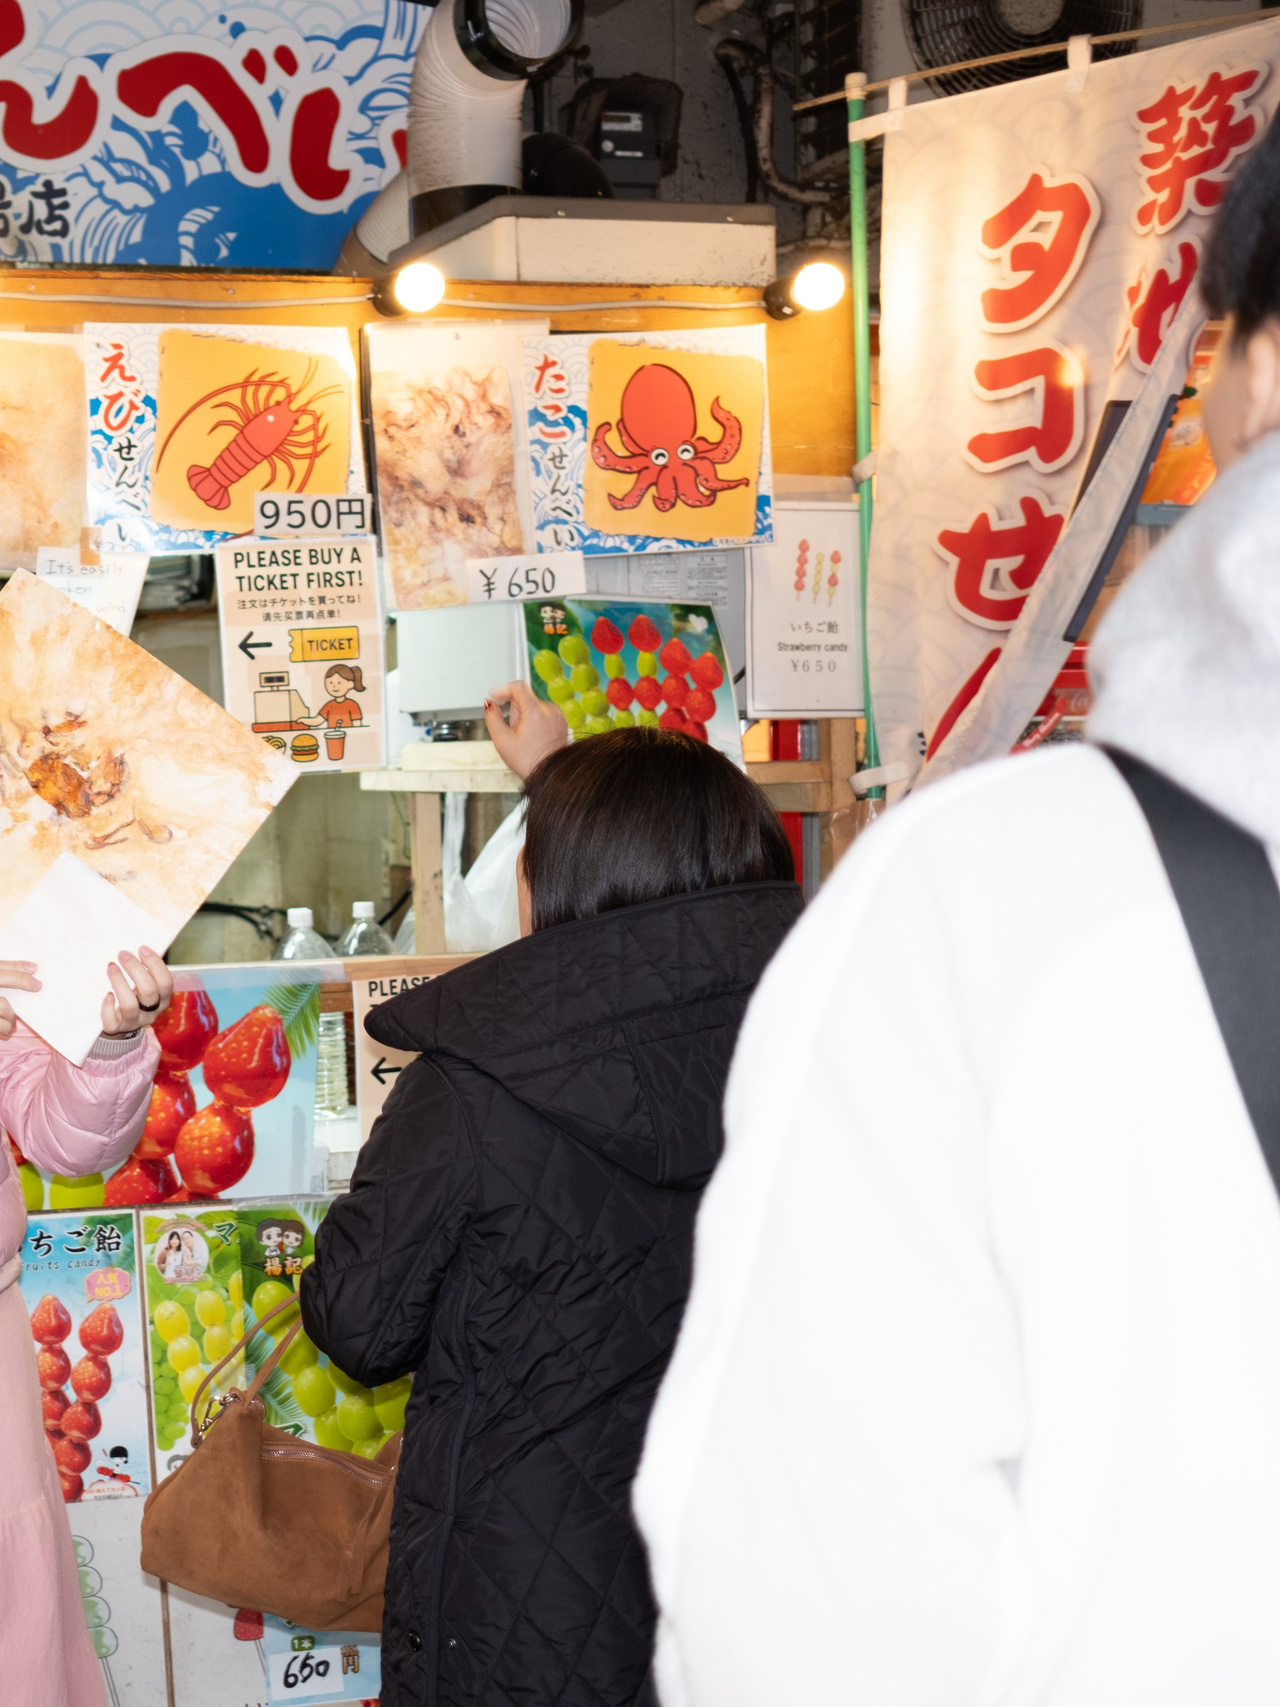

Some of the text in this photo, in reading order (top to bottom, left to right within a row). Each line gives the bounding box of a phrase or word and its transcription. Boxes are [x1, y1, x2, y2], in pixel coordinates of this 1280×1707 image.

[534, 353, 575, 547] たこせんべい
[259, 497, 366, 531] 950円
[233, 547, 362, 569] PLEASE BUY A
[235, 570, 364, 592] TICKET FIRST!
[790, 620, 839, 634] いちご飴
[306, 637, 354, 652] TICKET
[777, 641, 848, 653] Strawberry candy
[368, 976, 431, 997] PLEAS
[18, 1226, 122, 1257] ちご飴
